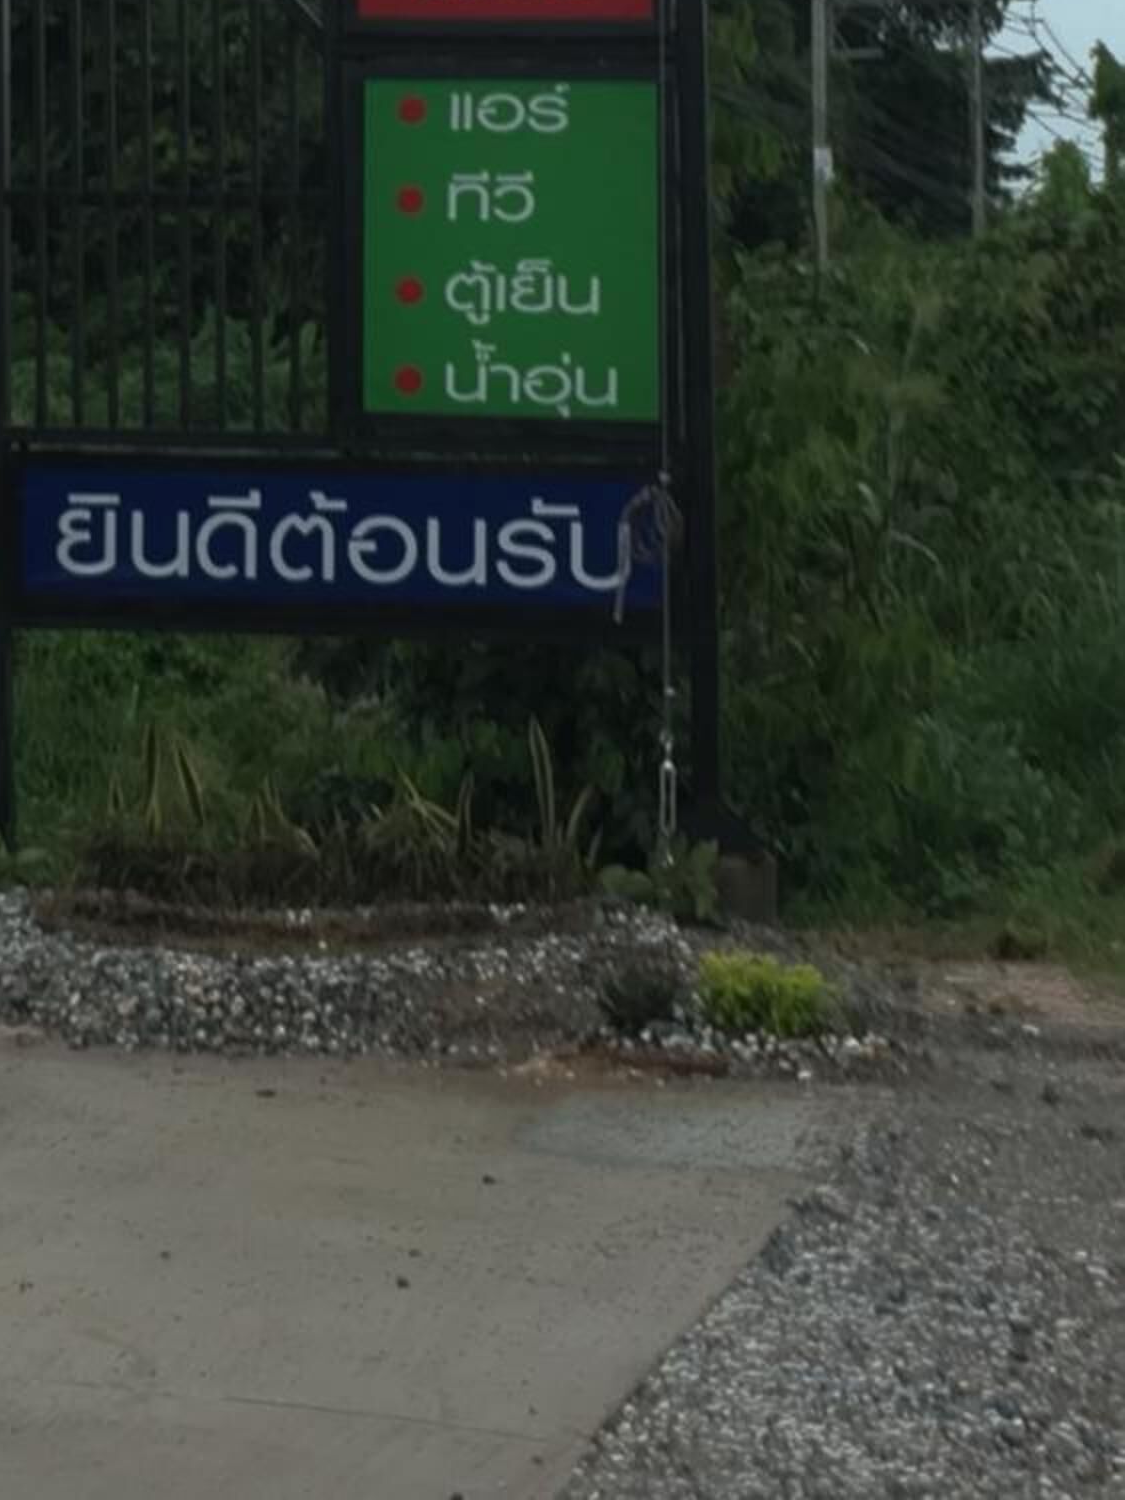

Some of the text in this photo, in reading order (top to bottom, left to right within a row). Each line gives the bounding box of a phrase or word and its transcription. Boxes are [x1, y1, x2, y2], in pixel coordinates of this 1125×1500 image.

[450, 83, 570, 133] แอร์
[447, 170, 535, 223] ทีวี
[444, 258, 600, 325] ตู้เย็น
[445, 339, 618, 419] น้ำอุ่น
[55, 488, 631, 591] ยินดีต้อนรับ
